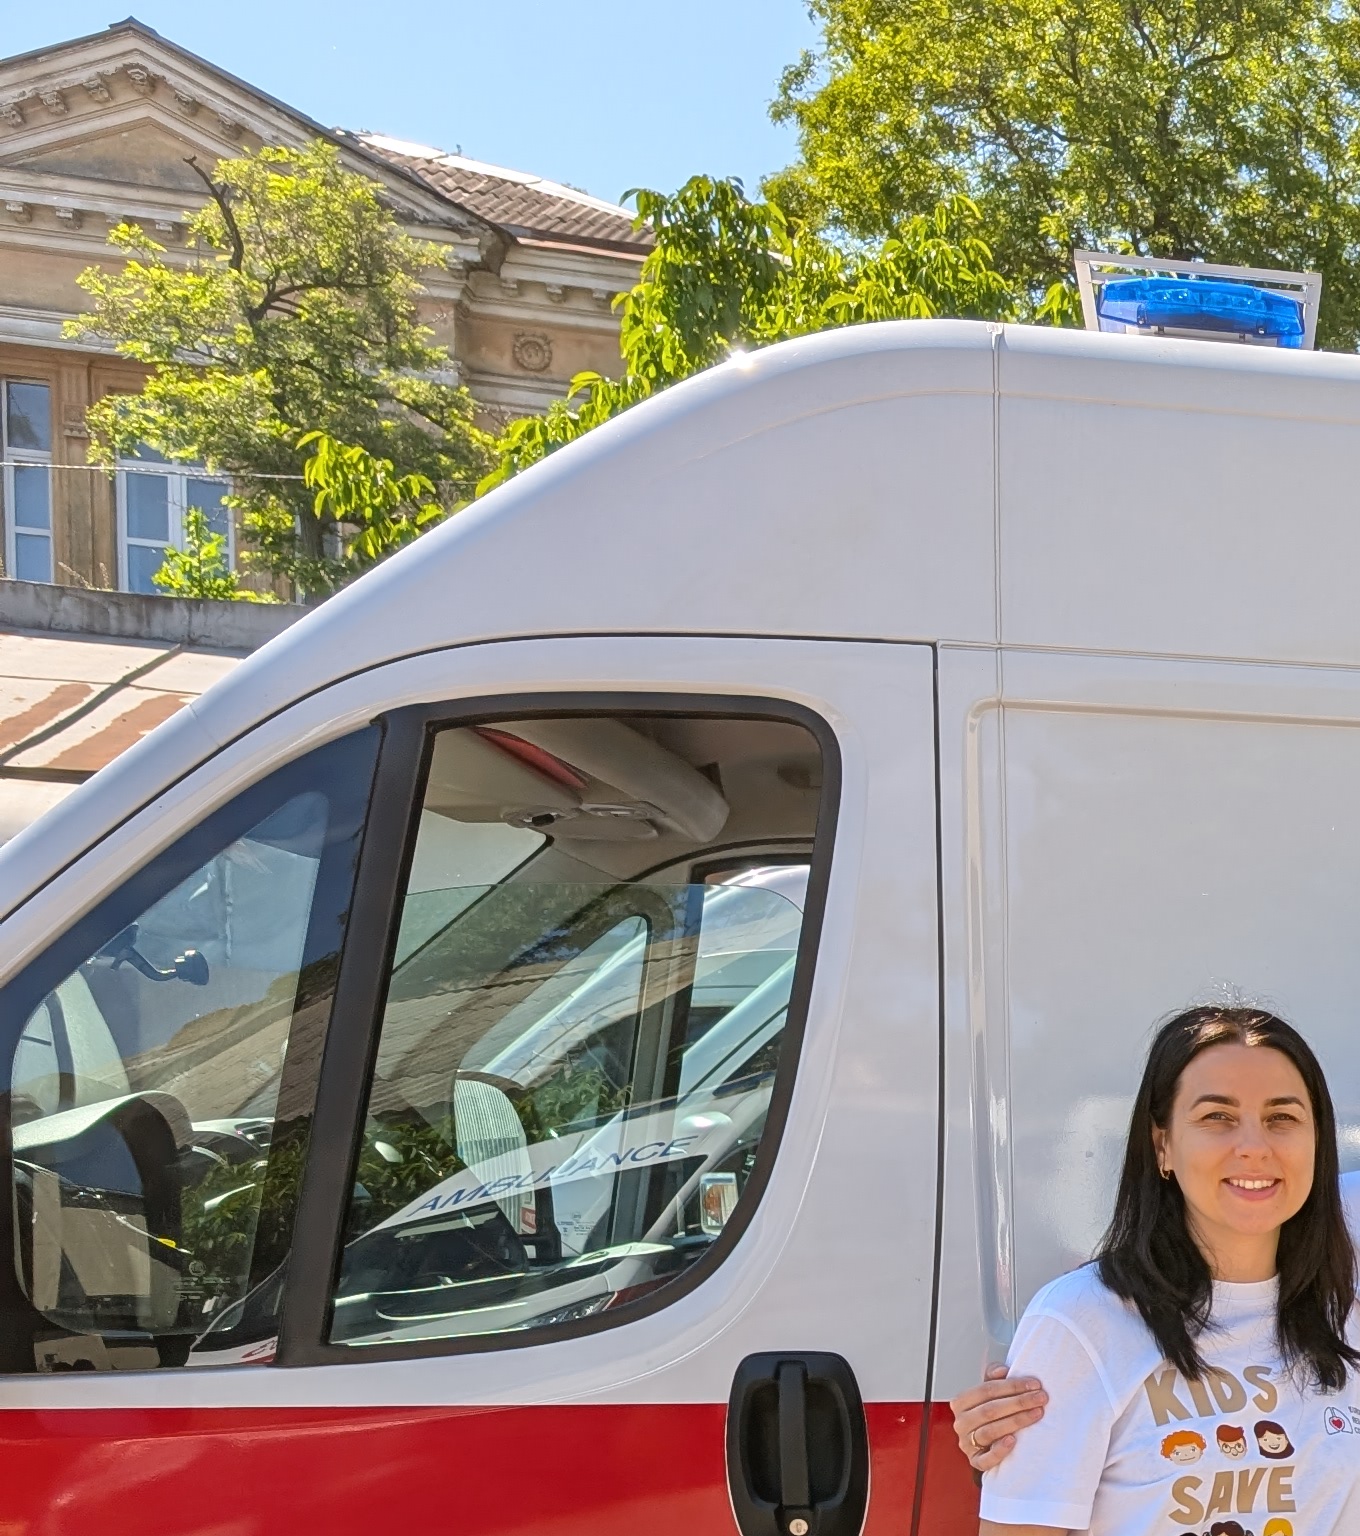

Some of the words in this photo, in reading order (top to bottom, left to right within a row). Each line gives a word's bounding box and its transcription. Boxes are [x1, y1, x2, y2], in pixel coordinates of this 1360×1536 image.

[406, 1135, 699, 1218] AMBULANCE
[1144, 1365, 1279, 1428] KIDS
[1168, 1465, 1297, 1526] SAVE
